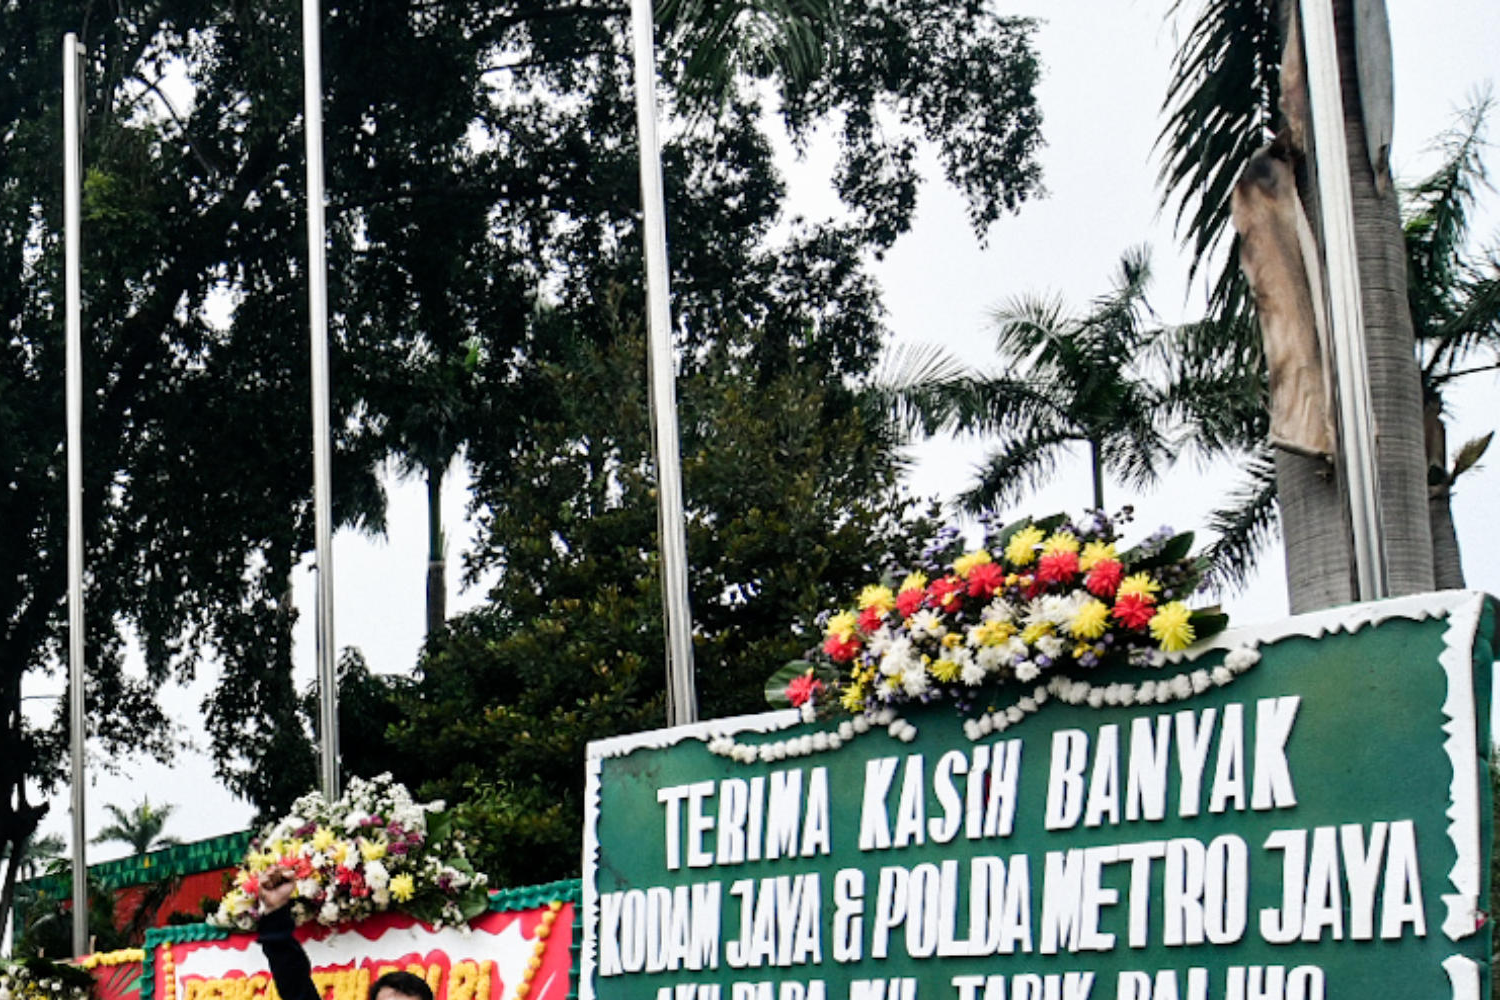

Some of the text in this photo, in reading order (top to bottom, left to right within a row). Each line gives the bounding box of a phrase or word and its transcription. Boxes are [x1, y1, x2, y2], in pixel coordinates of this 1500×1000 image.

[657, 695, 1300, 871] TERIMA KASIH BANYAK
[600, 818, 1428, 978] KODAM JAYA & POLDA METRO JAYA
